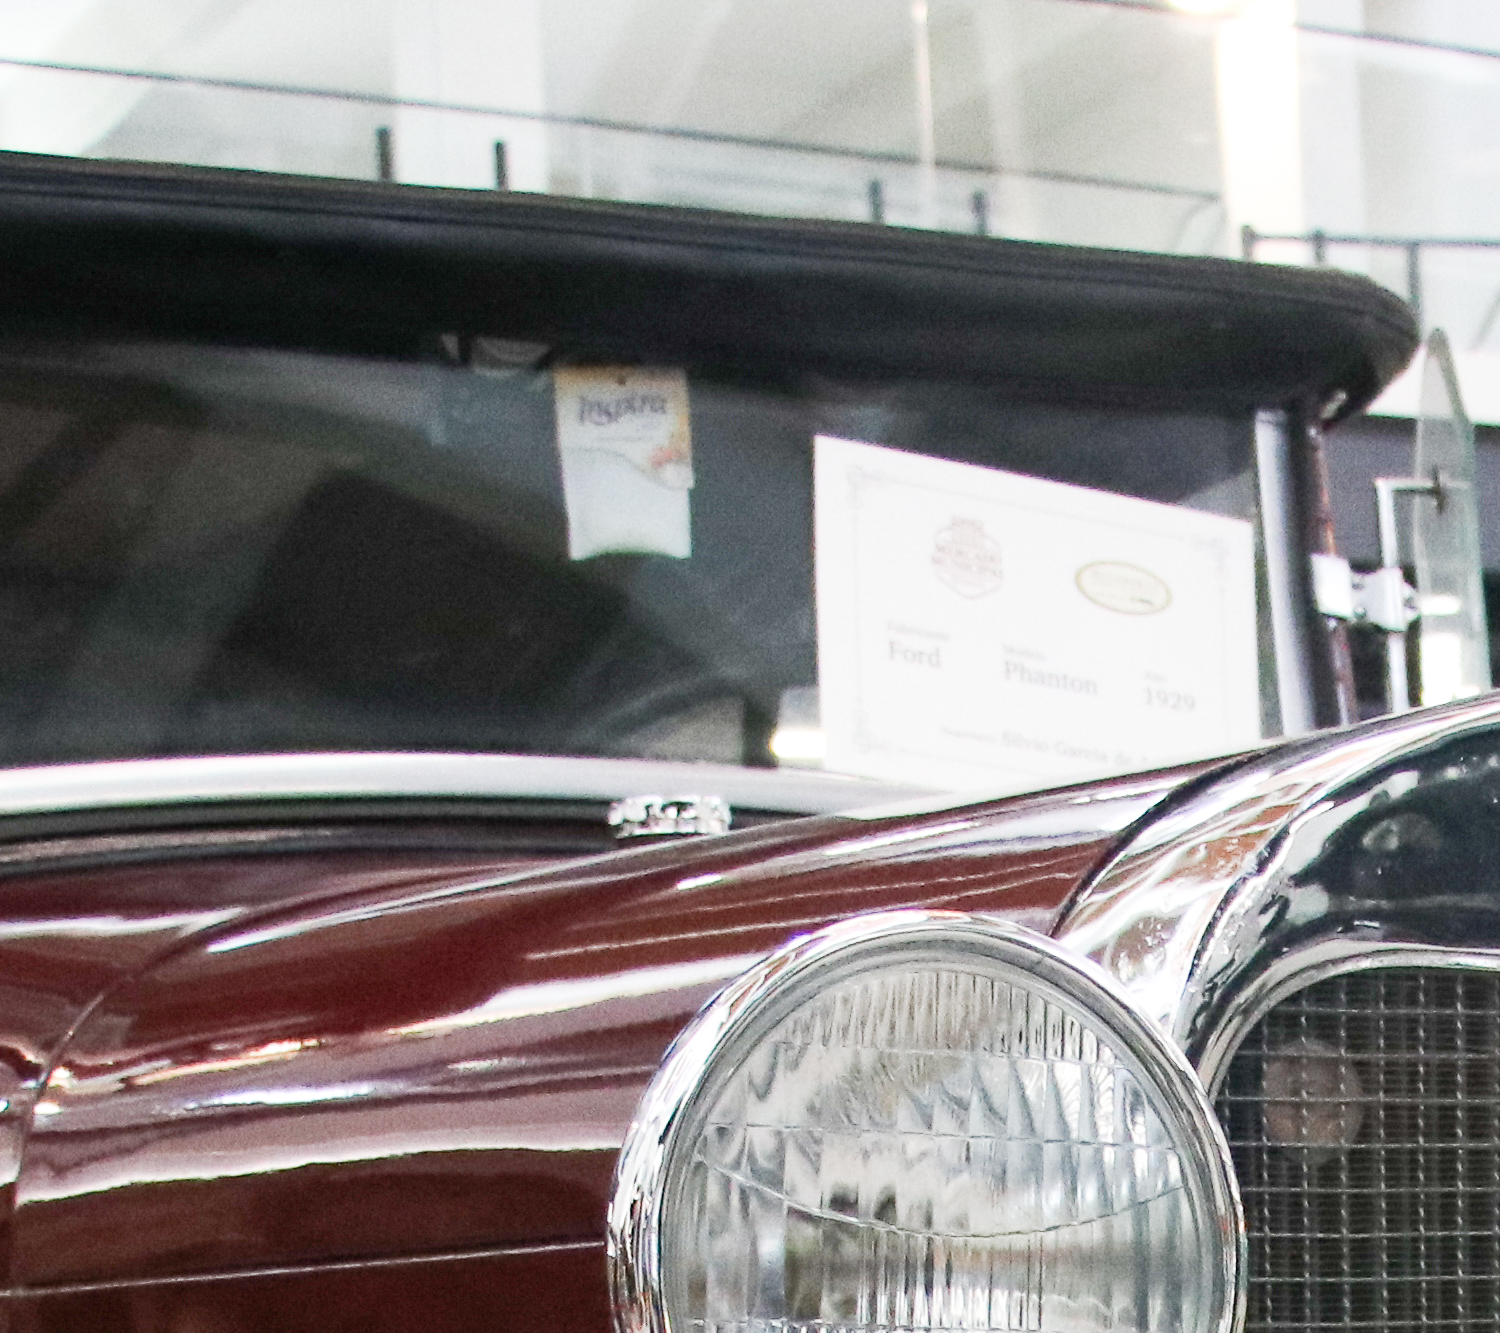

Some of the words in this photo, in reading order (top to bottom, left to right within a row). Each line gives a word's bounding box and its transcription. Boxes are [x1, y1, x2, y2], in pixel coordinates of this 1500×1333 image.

[887, 639, 943, 669] Ford
[1002, 659, 1100, 697] Phanton
[1143, 686, 1198, 713] 1929
